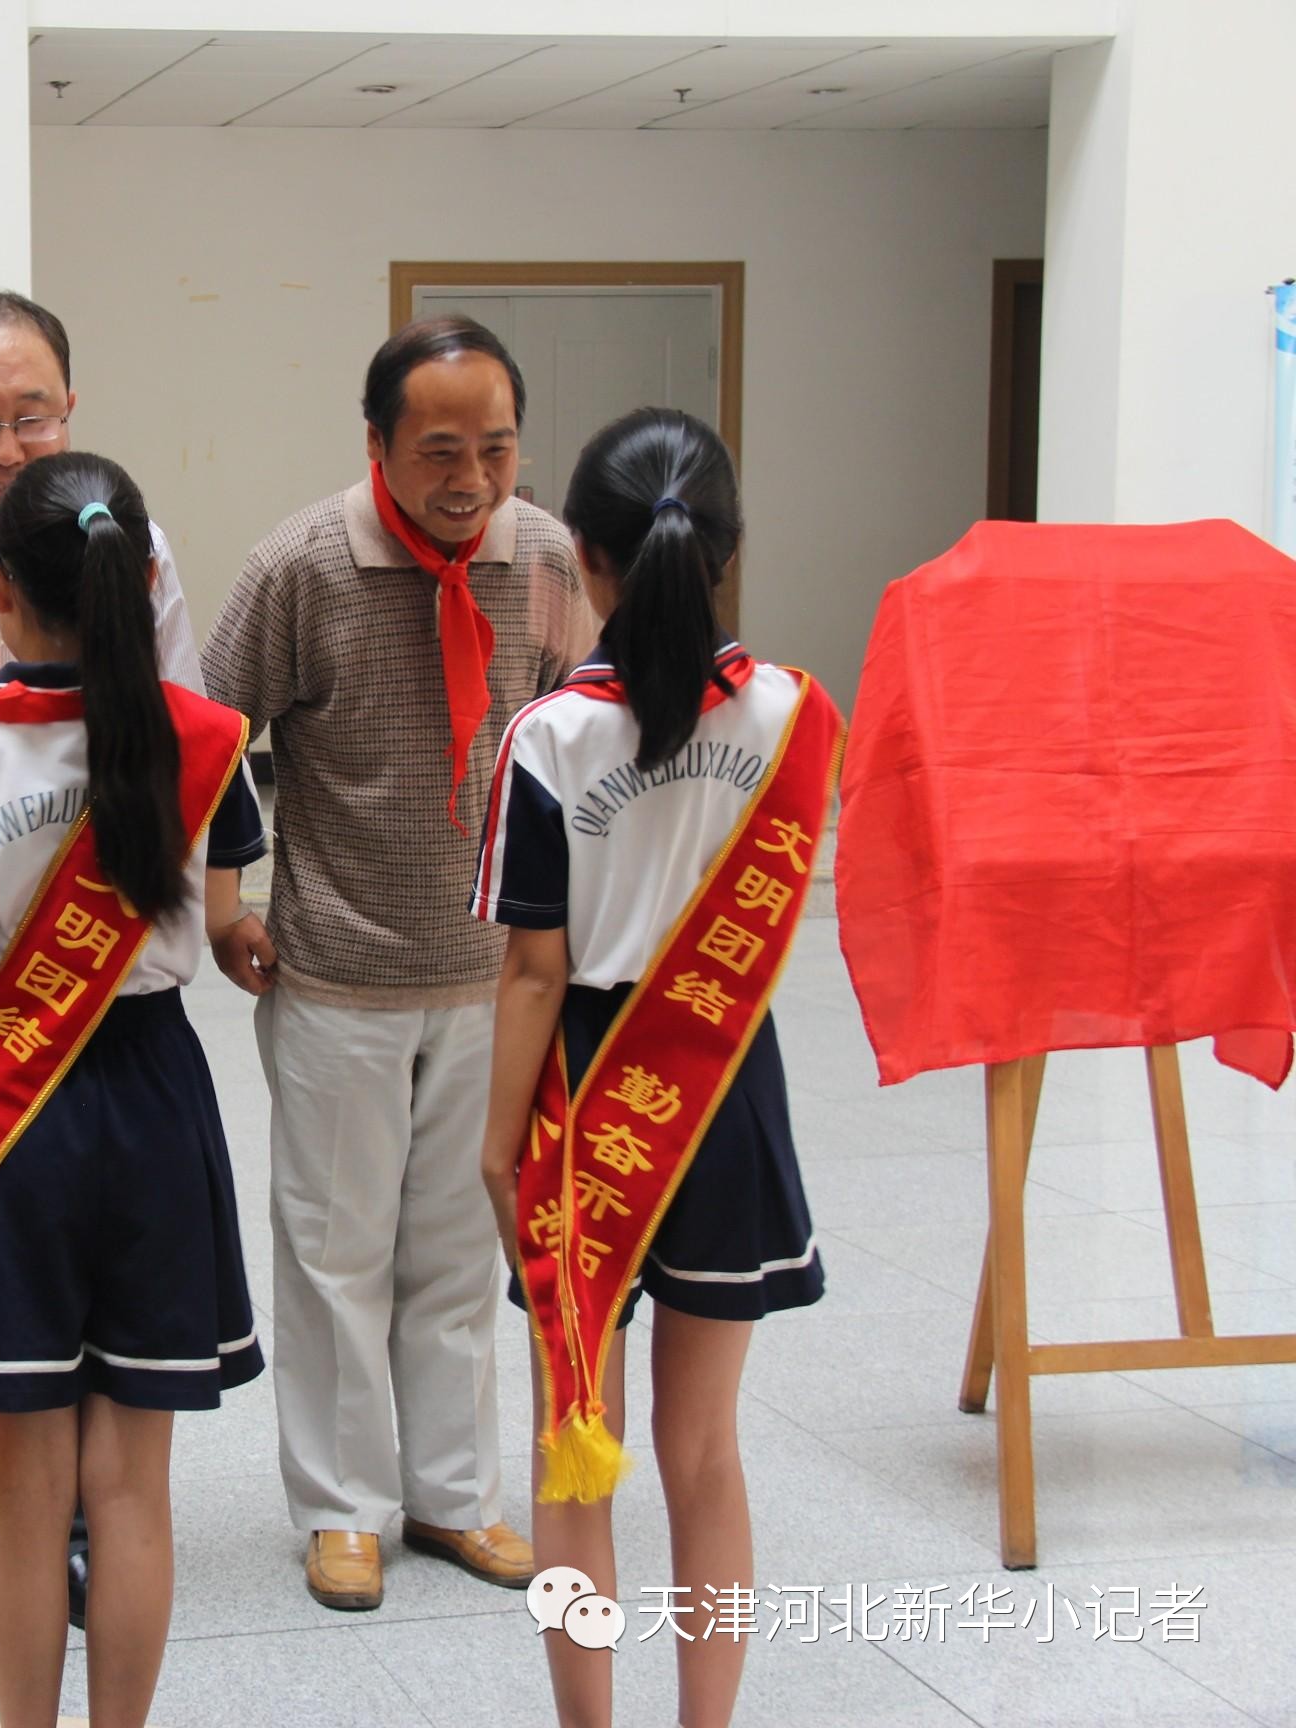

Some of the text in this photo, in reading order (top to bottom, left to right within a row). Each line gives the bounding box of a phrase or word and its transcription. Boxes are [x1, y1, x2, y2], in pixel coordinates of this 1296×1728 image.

[571, 741, 770, 838] QIANWEILUXIAO
[663, 817, 813, 1026] 文明团结
